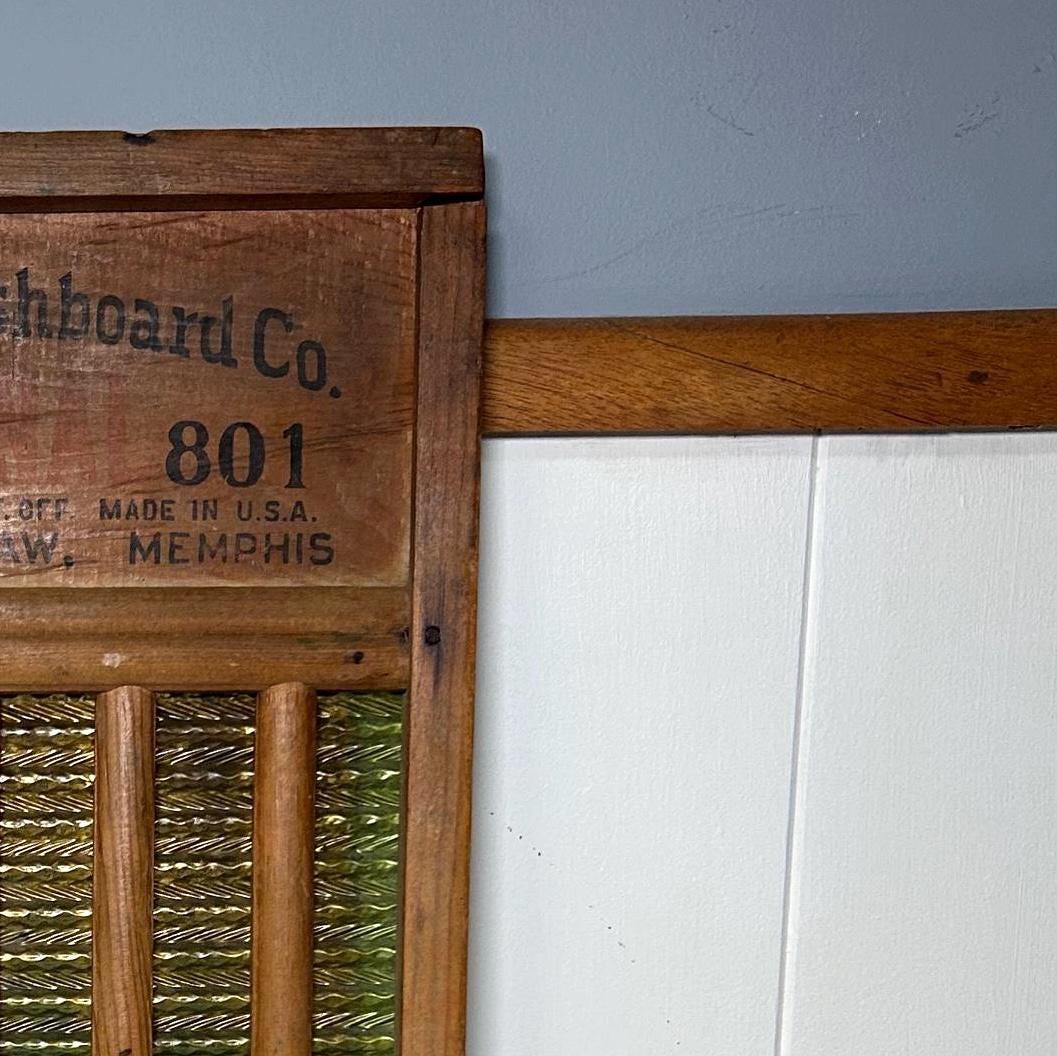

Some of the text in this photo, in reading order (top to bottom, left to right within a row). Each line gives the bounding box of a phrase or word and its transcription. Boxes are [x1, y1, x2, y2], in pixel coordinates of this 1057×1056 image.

[253, 307, 341, 398] Co.
[164, 420, 306, 489] 801
[98, 498, 175, 521] MADE
[191, 499, 218, 521] IN
[236, 500, 318, 522] U.S.A.
[128, 530, 335, 565] MEMPHIS
